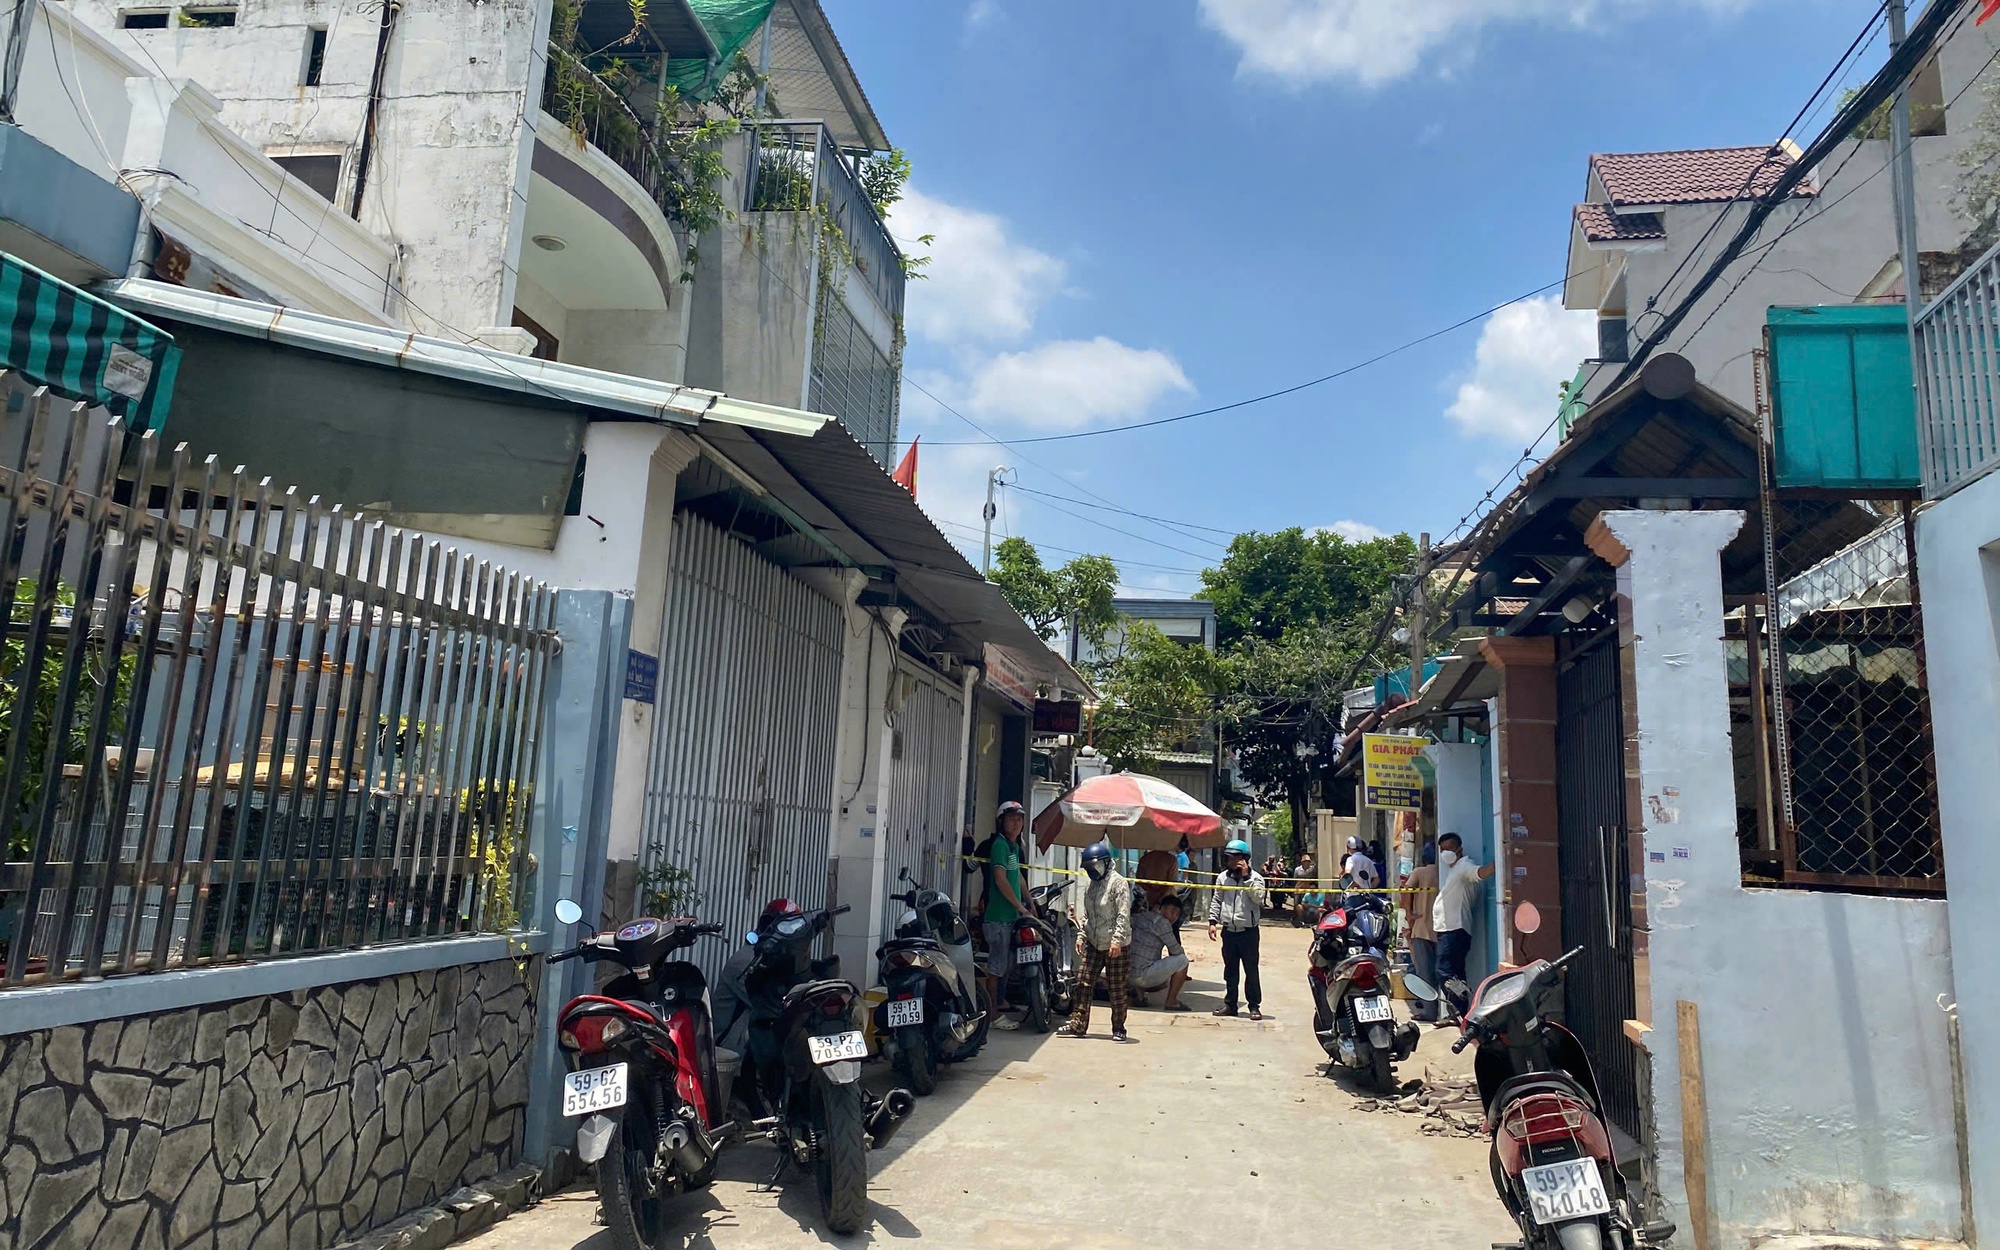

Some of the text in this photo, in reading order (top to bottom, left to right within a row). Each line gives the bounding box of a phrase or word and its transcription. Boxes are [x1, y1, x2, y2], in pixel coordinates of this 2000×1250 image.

[1372, 744, 1390, 754] GIA
[893, 1000, 918, 1014] 59-Y3
[1360, 1008, 1389, 1021] 230.43
[817, 1034, 855, 1049] 59-P2
[814, 1043, 864, 1061] 705.90
[574, 1068, 617, 1092] 59-G2
[567, 1086, 622, 1112] 554.56
[1534, 1164, 1588, 1192] 59-Y1
[1533, 1187, 1604, 1219] 640.48
